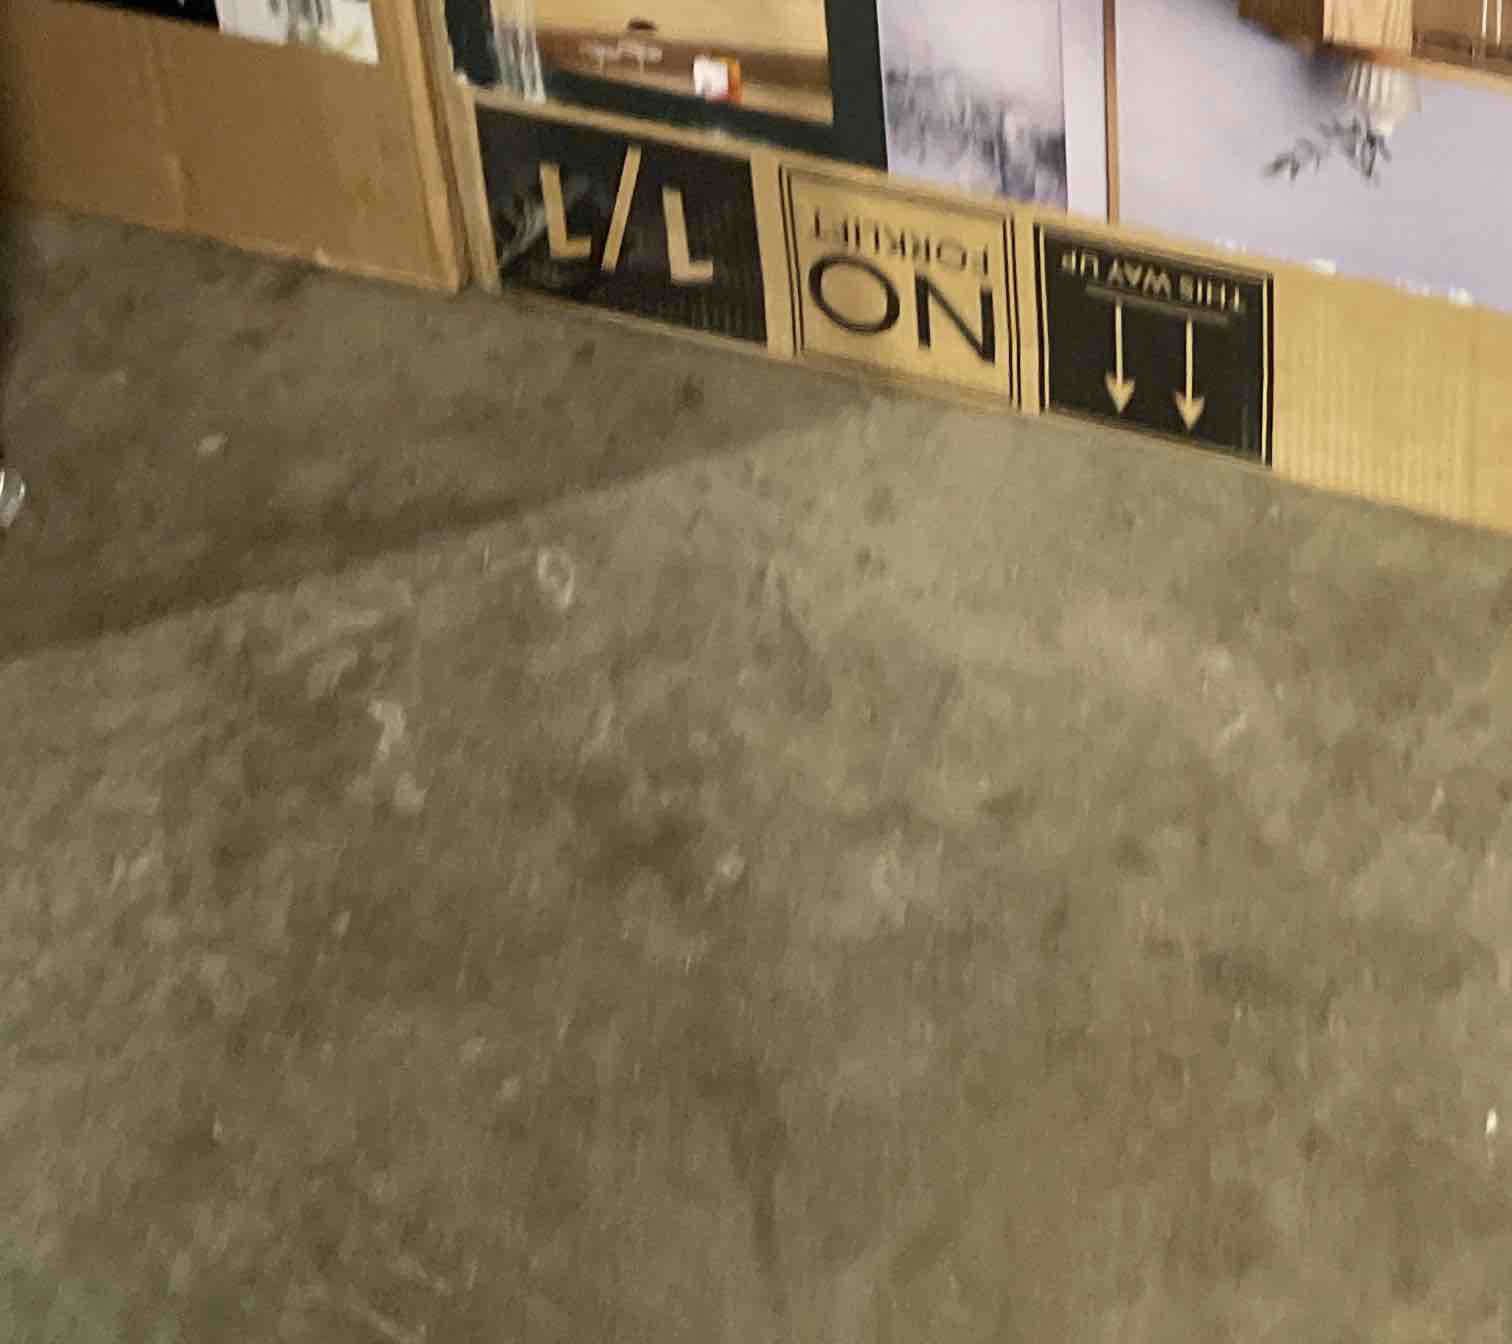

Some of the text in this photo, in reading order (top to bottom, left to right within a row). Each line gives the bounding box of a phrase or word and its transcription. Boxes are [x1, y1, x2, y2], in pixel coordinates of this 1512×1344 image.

[538, 145, 714, 284] 1/1
[809, 209, 988, 276] FORKLIFT
[807, 258, 996, 365] NO
[1061, 248, 1246, 313] THIS WAY UP
